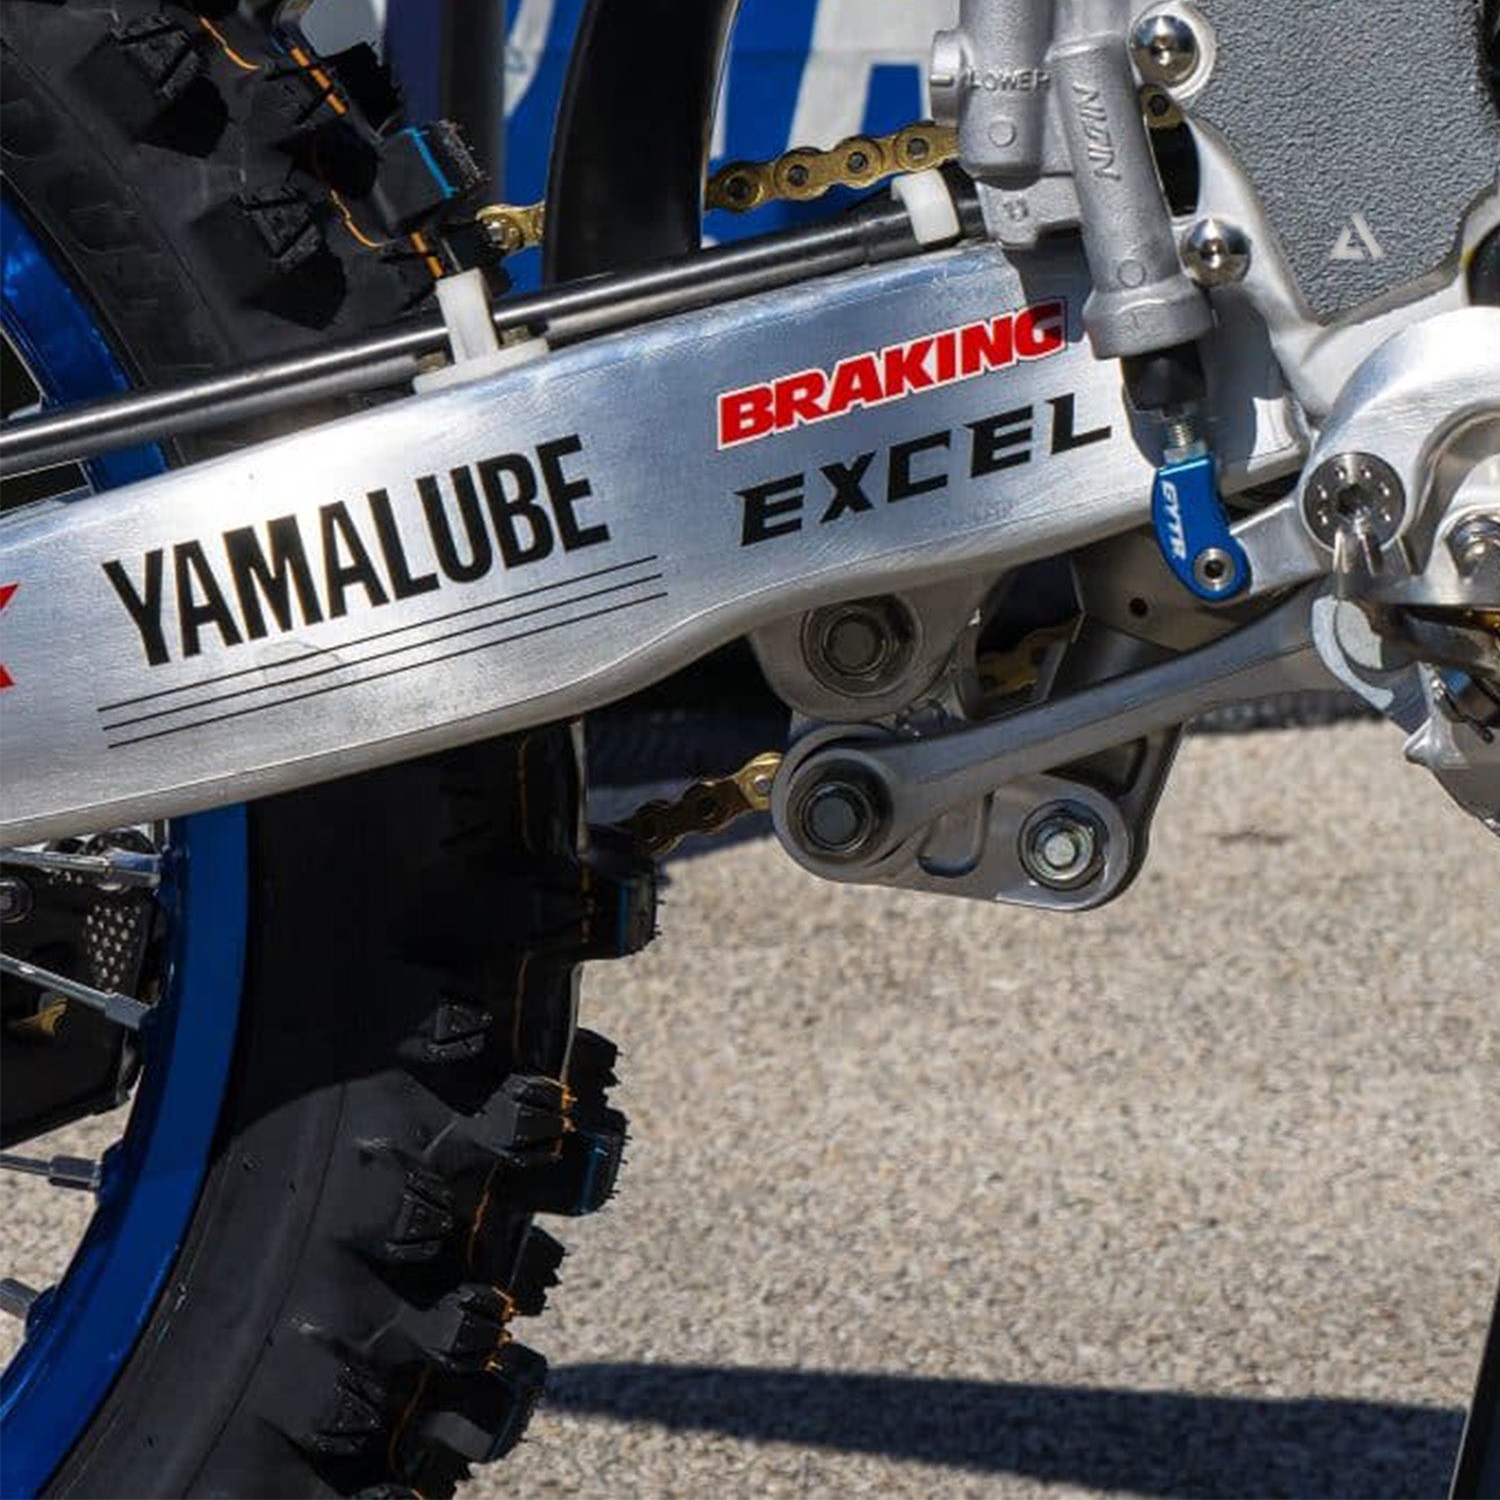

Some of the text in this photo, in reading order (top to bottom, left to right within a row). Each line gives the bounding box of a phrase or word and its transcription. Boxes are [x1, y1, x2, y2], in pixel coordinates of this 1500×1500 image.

[717, 302, 1066, 450] BRAKING
[734, 393, 1111, 546] EXCEL
[102, 434, 609, 666] YAMALUBE
